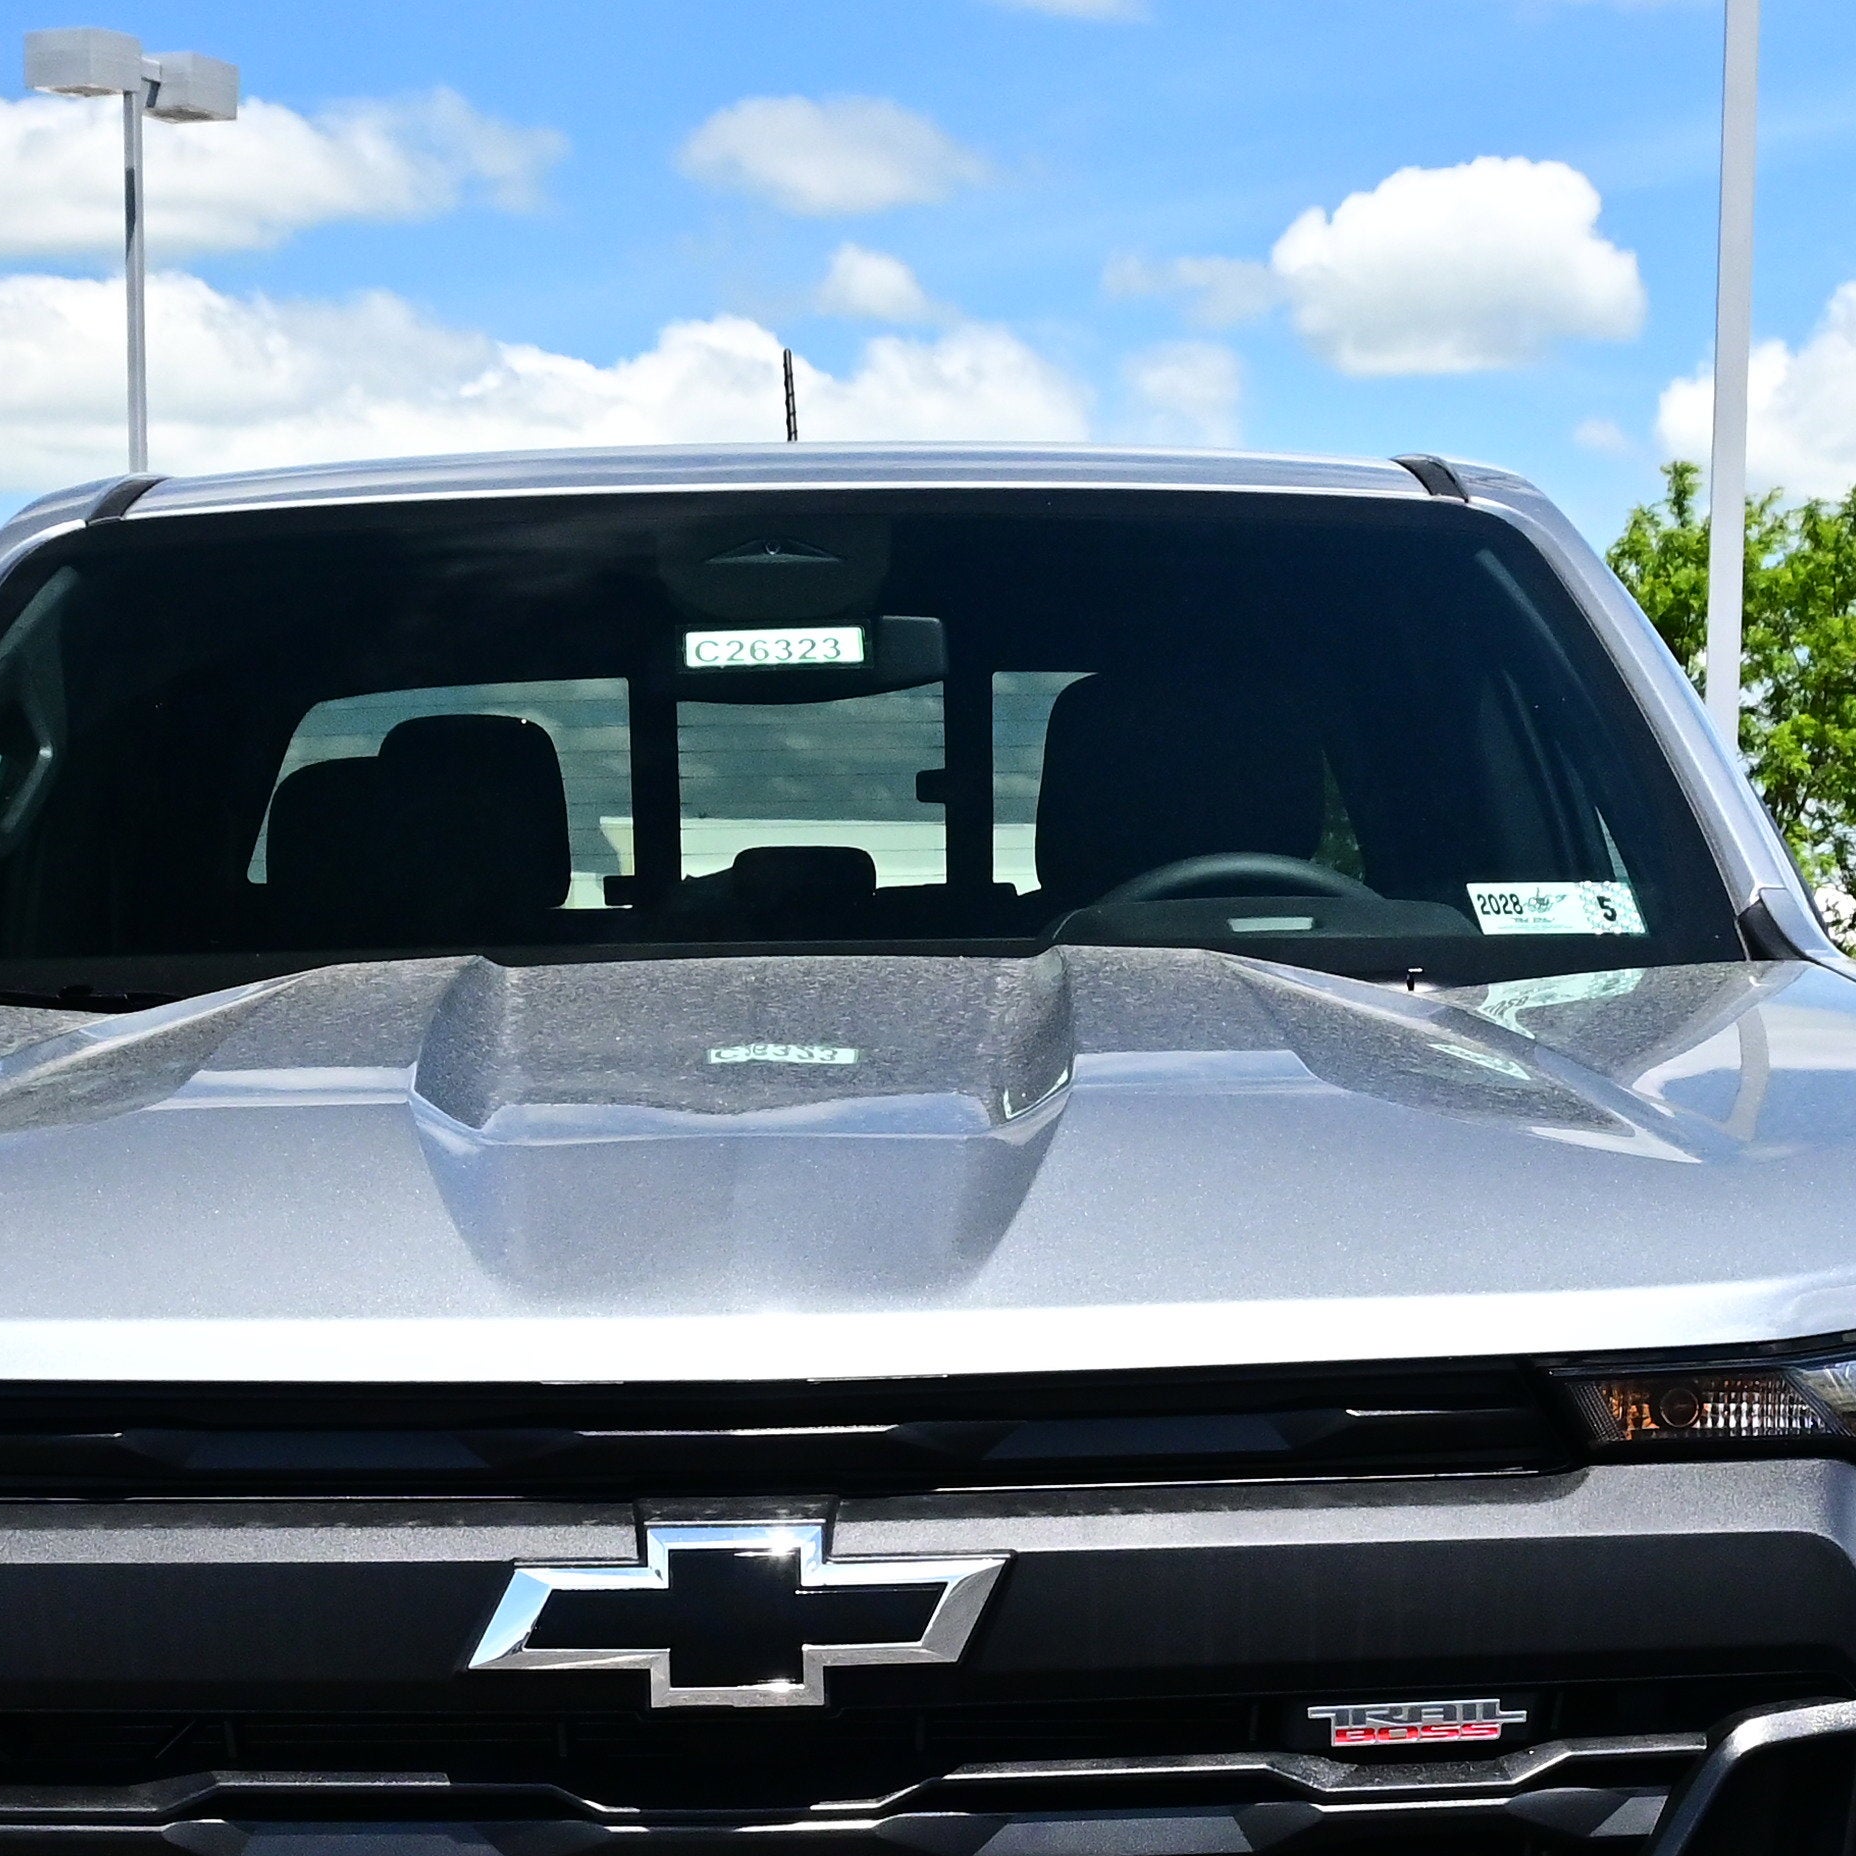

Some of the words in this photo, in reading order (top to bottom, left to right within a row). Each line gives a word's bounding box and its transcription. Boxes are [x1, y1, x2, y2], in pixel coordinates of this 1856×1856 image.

[694, 638, 842, 662] C26323
[1477, 893, 1524, 915] 2028
[1597, 895, 1618, 922] 5
[1308, 1699, 1526, 1726] TRAIL
[1333, 1723, 1500, 1747] BOSS
